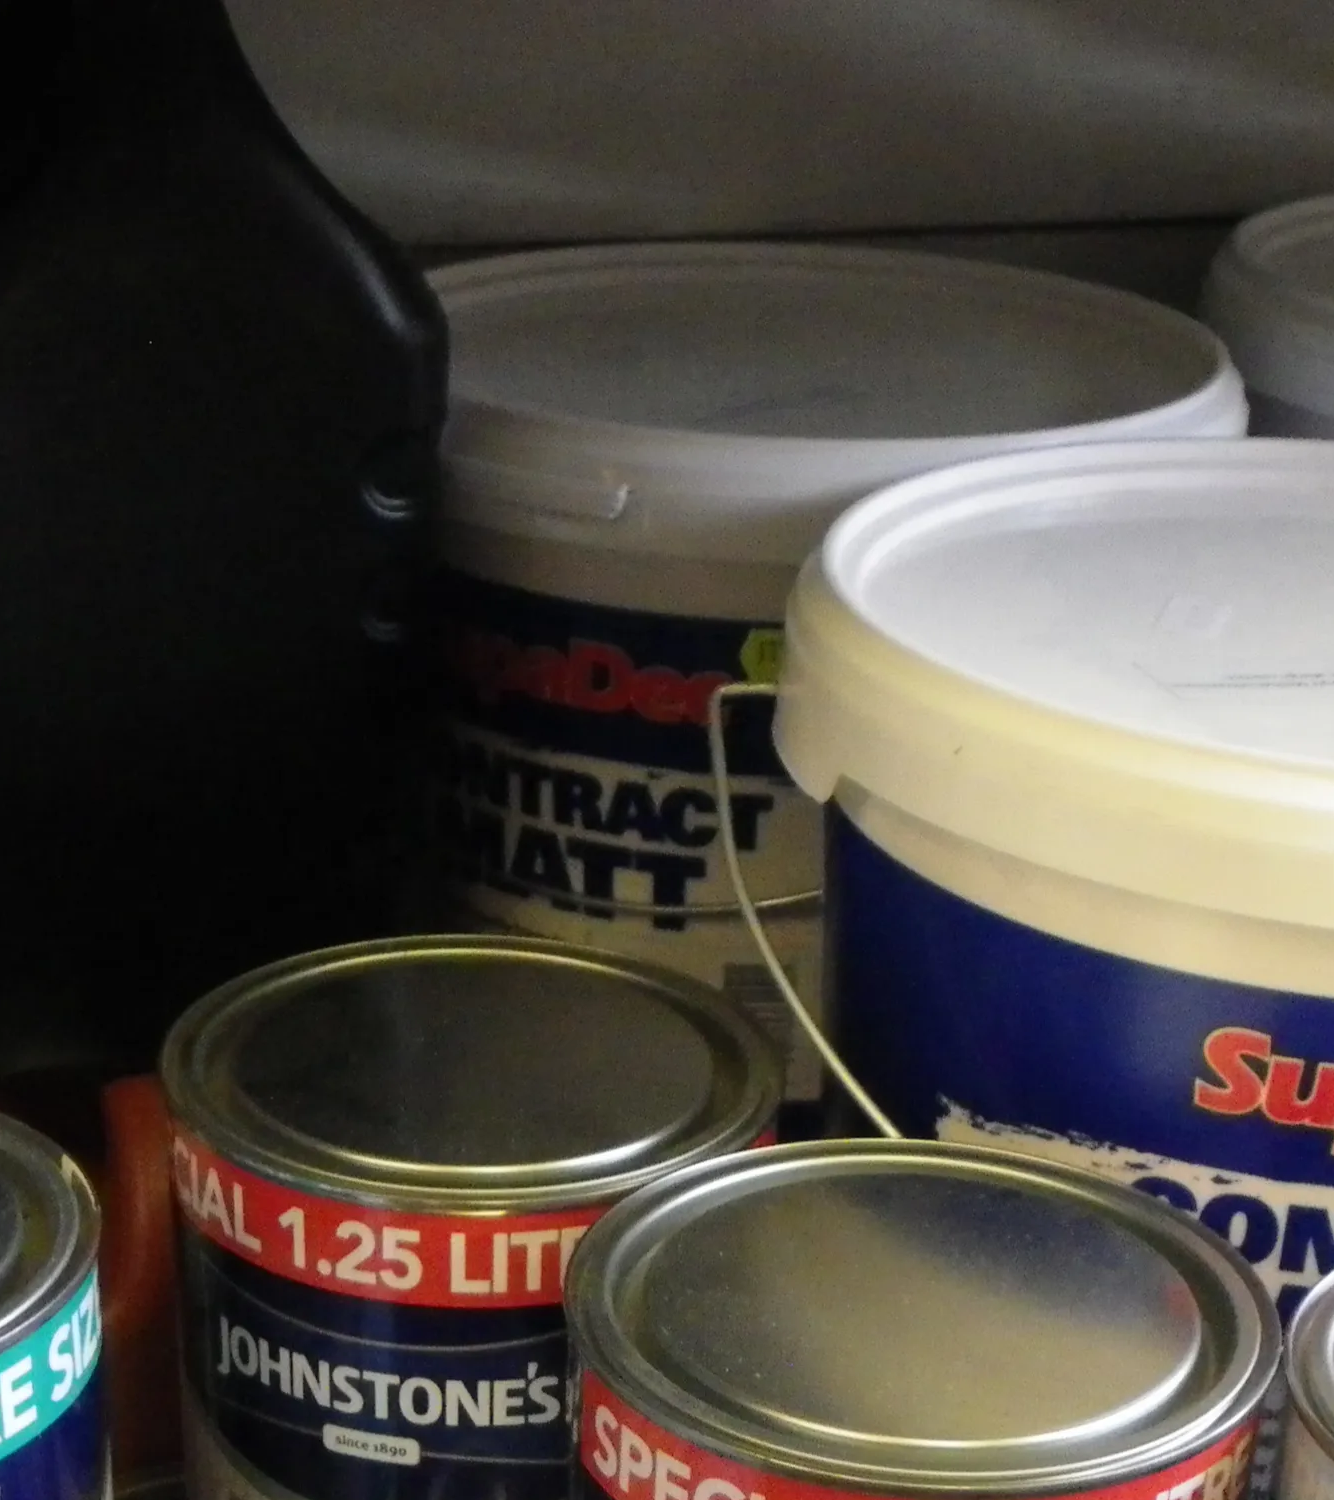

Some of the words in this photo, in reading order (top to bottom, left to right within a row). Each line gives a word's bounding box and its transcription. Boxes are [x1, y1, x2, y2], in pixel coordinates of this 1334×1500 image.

[276, 1206, 423, 1292] 1.25
[216, 1315, 562, 1428] JOHNSTONE'S
[333, 1432, 371, 1452] since
[371, 1437, 407, 1459] 1890
